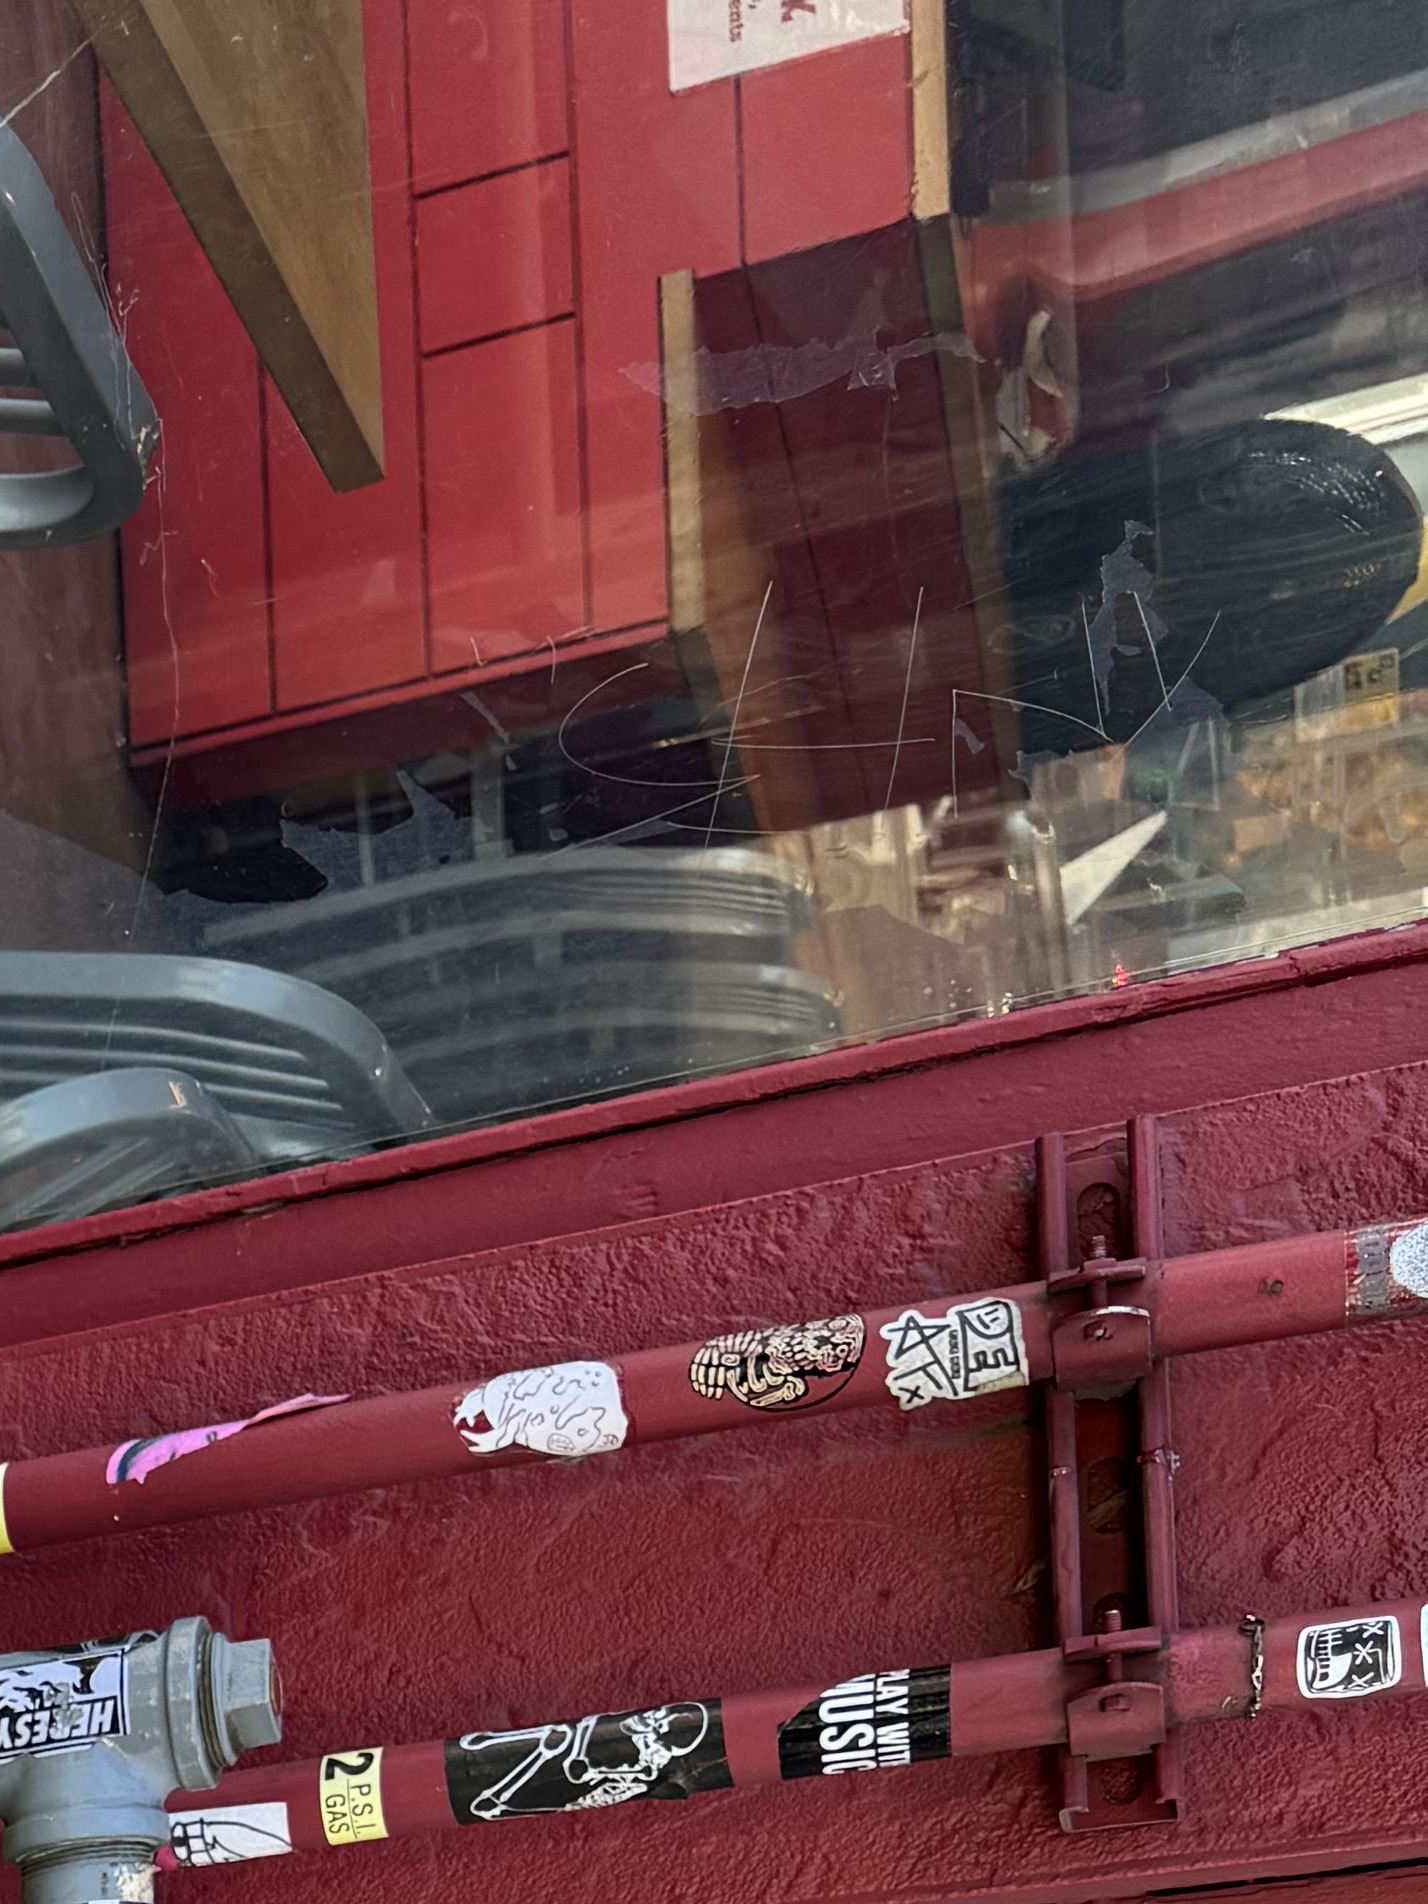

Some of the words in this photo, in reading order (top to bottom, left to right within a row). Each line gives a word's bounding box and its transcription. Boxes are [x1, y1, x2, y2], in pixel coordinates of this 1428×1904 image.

[818, 1674, 877, 1775] MUSIC
[324, 1752, 374, 1781] 2
[349, 1783, 377, 1836] P.S.I.
[325, 1793, 350, 1835] GAS
